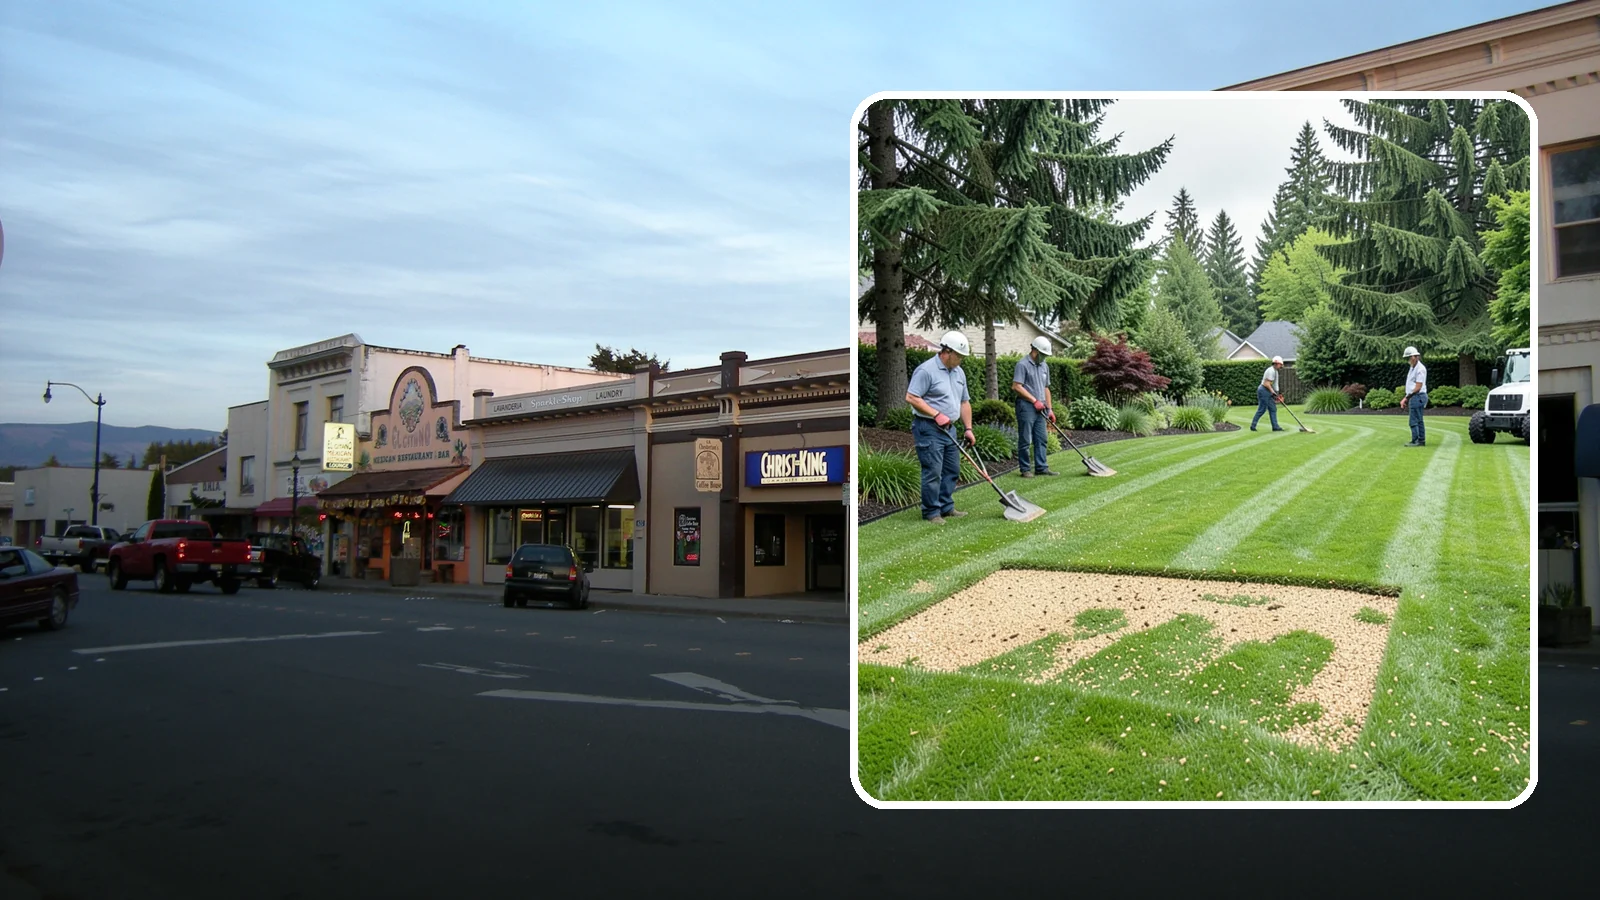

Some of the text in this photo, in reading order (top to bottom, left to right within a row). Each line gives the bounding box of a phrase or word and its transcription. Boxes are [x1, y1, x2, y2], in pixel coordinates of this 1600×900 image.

[531, 394, 583, 409] Sparkle Shop
[596, 389, 624, 400] LAUNDRY
[494, 402, 523, 413] LAVANDERIA
[373, 455, 397, 464] MEXICAN
[397, 452, 433, 462] RESTAURANT
[438, 450, 450, 459] BAR
[761, 450, 827, 477] CHRIST KING
